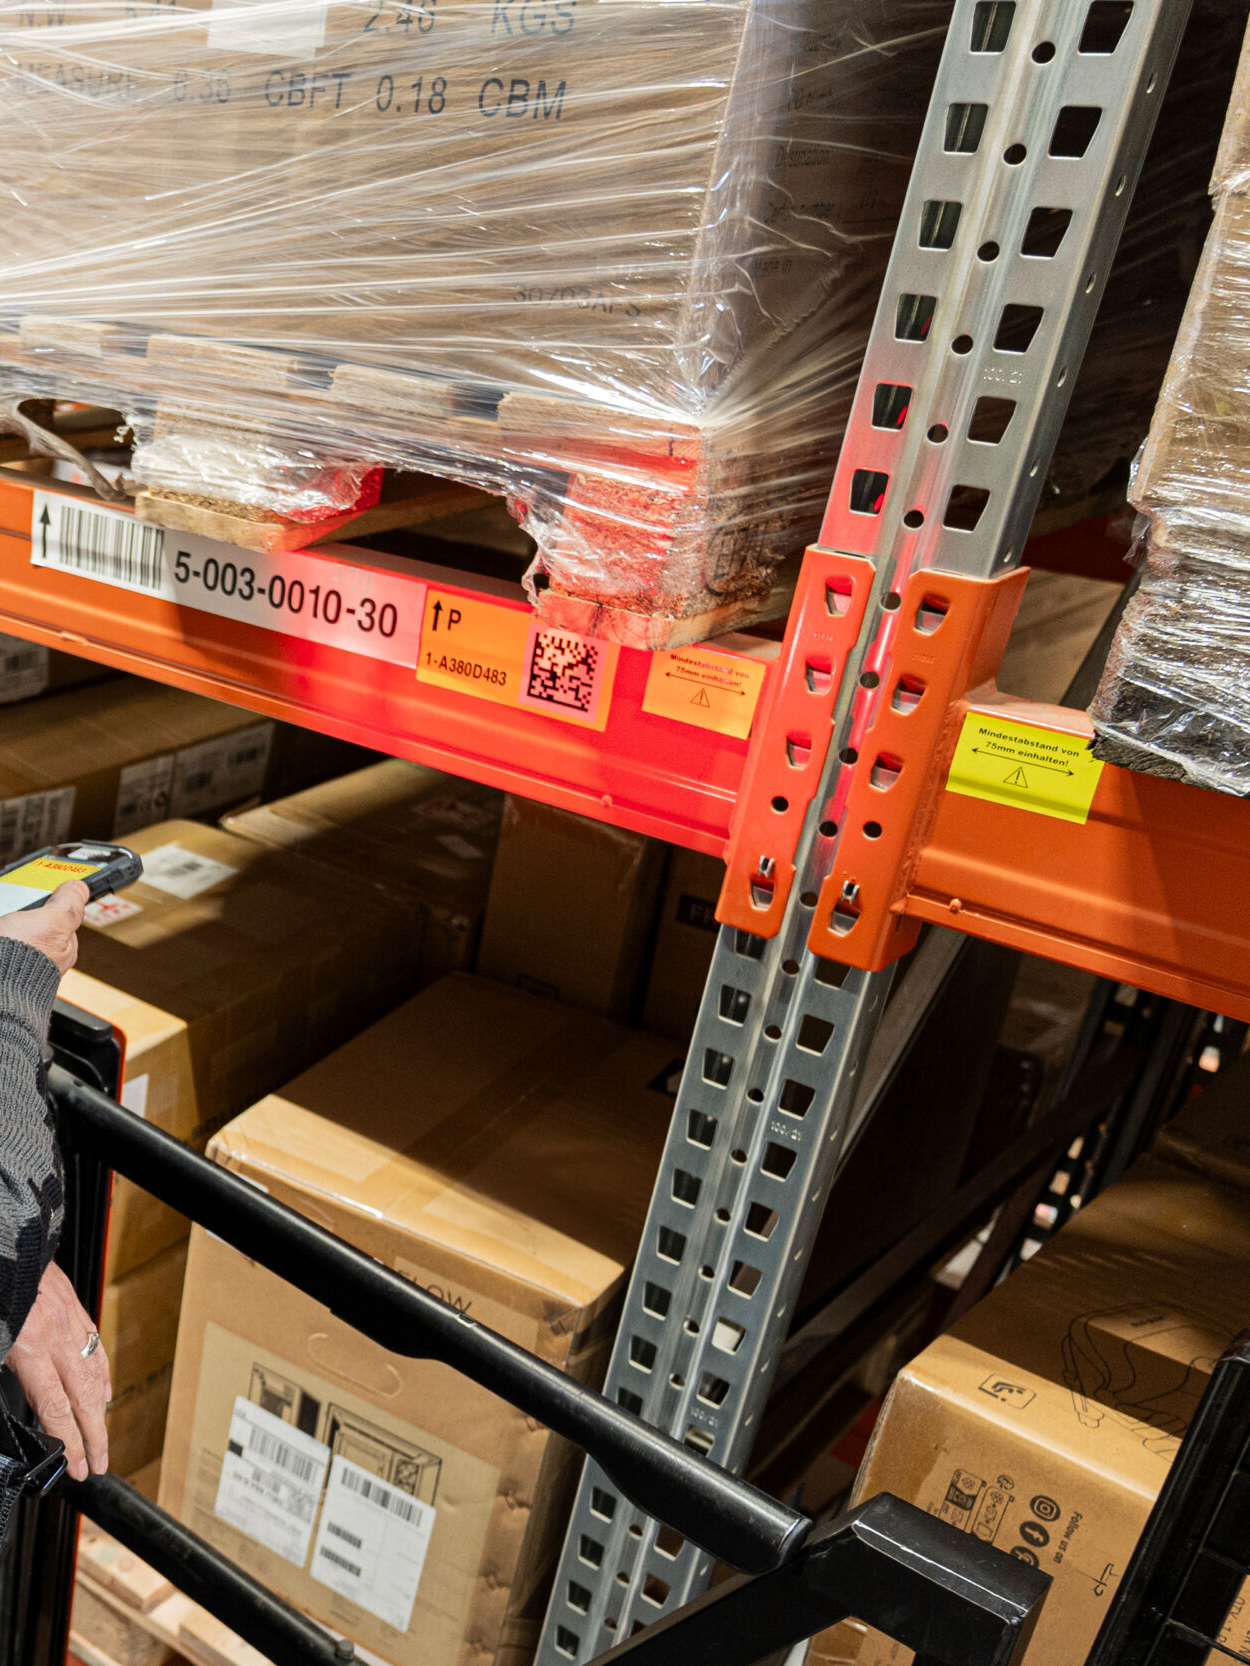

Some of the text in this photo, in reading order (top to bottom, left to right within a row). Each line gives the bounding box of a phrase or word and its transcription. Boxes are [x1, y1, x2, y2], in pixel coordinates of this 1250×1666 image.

[491, 0, 576, 35] KGS
[264, 70, 352, 110] CBFT
[375, 74, 448, 115] 0.18
[478, 77, 567, 121] CBM
[174, 550, 398, 638] 5-003-0010-30
[447, 608, 462, 631] P
[426, 651, 507, 686] 1-A380D483
[978, 727, 1080, 758] Mindestabstand von
[985, 741, 1069, 768] 75mm einhalten!
[1053, 1511, 1083, 1564] Follow us on
